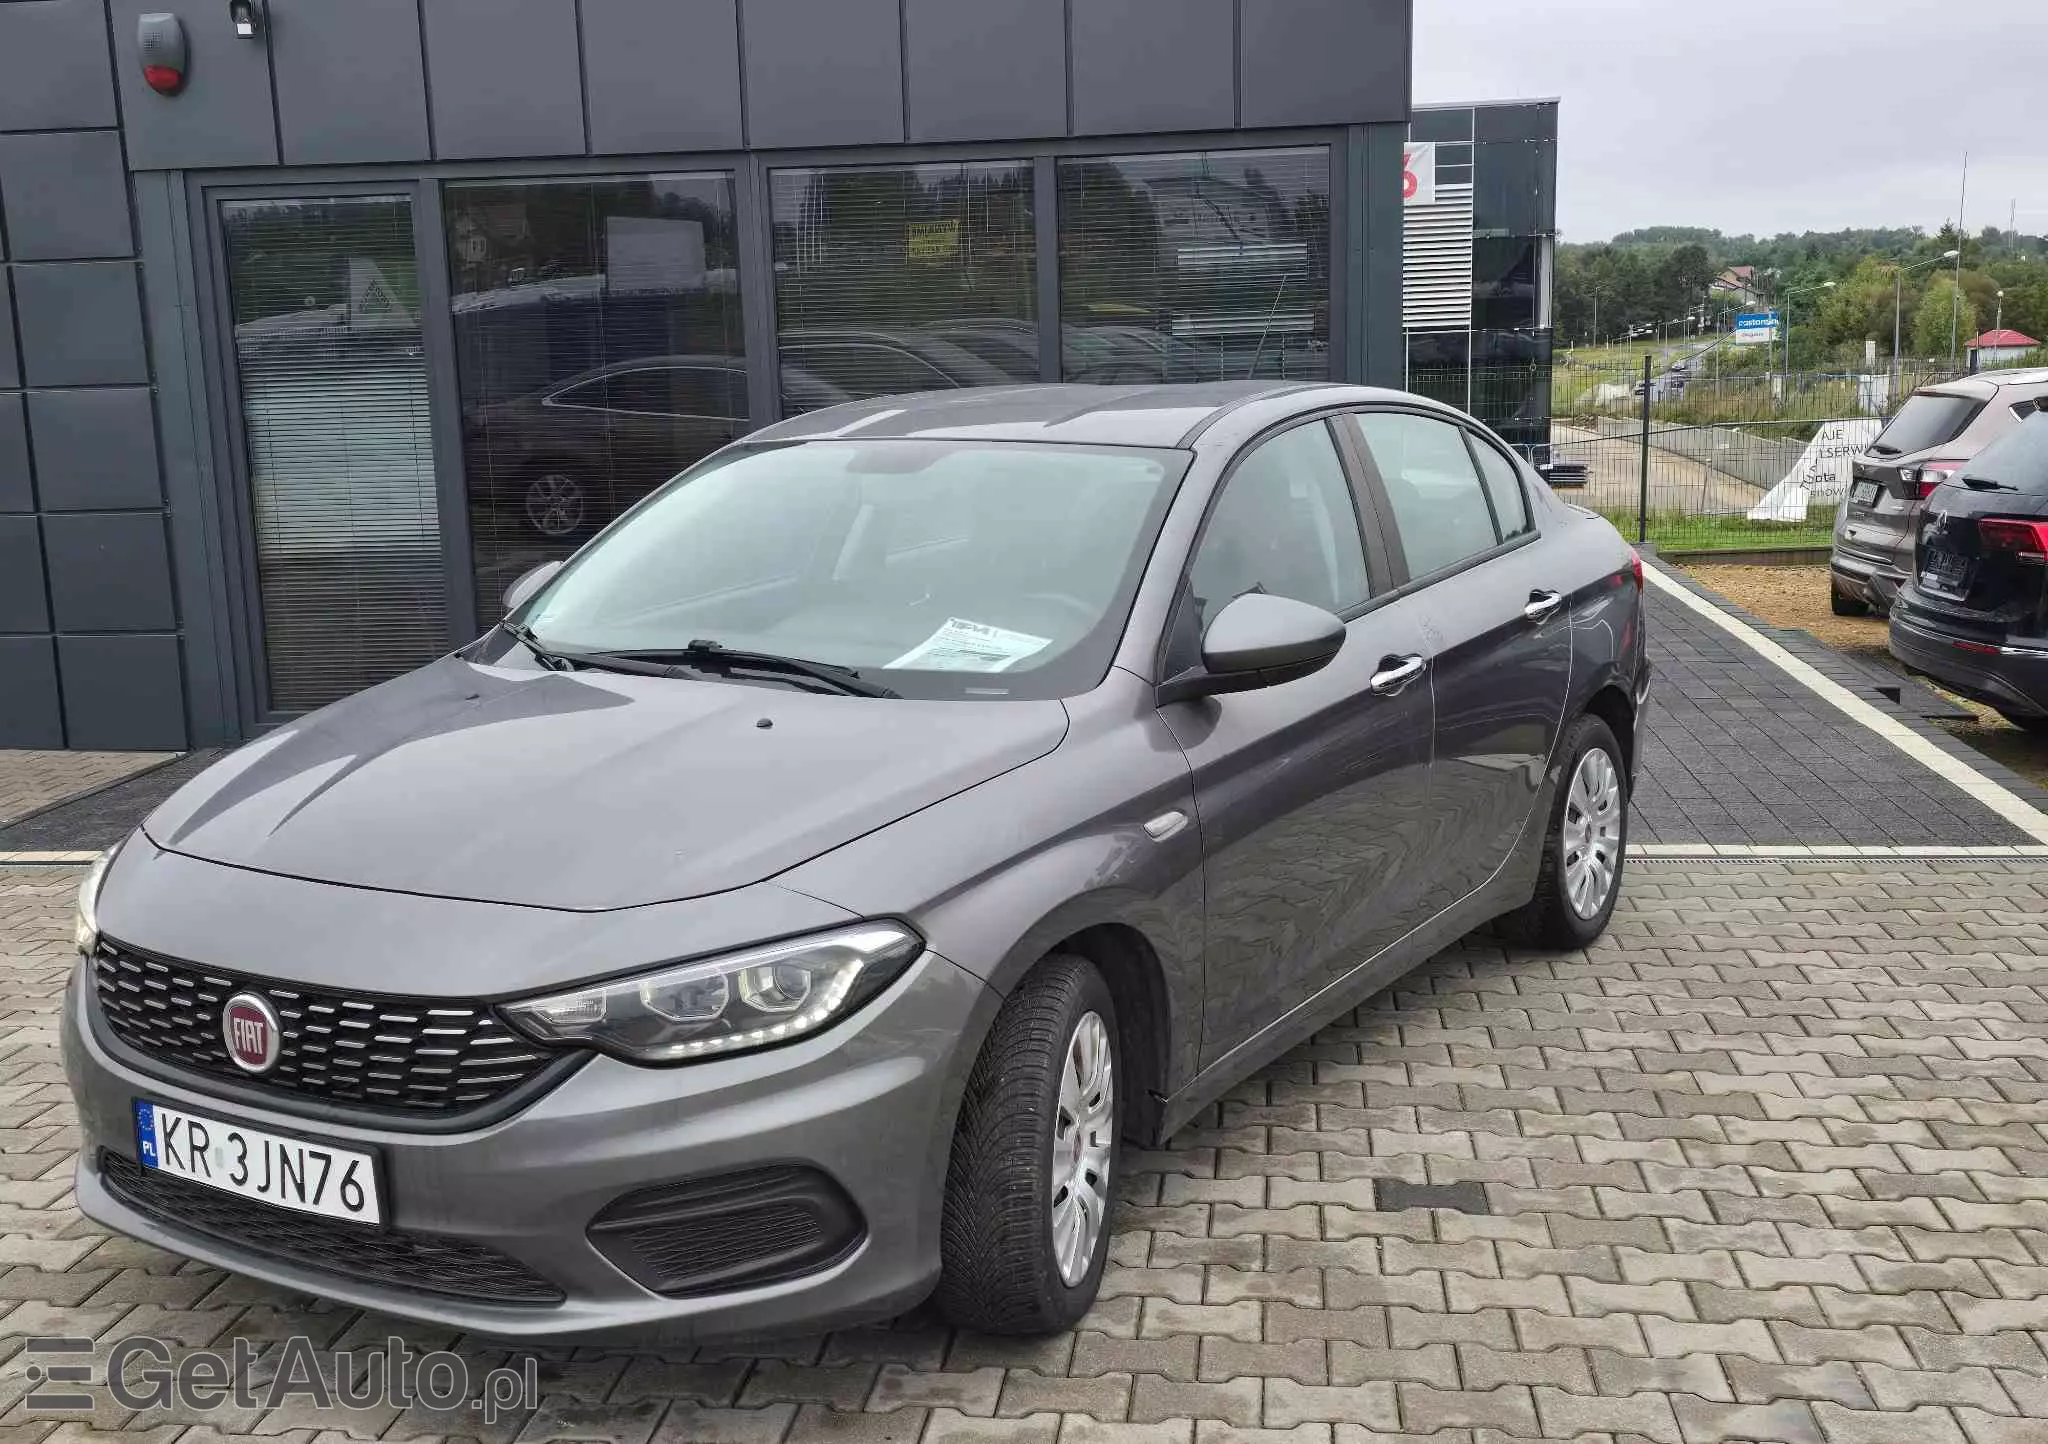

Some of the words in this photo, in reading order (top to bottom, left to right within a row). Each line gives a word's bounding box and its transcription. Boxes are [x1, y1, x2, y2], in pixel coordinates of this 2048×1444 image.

[233, 1016, 264, 1055] FIAT
[142, 1140, 157, 1157] PL
[162, 1113, 212, 1179] KR
[227, 1132, 365, 1212] 3JN76
